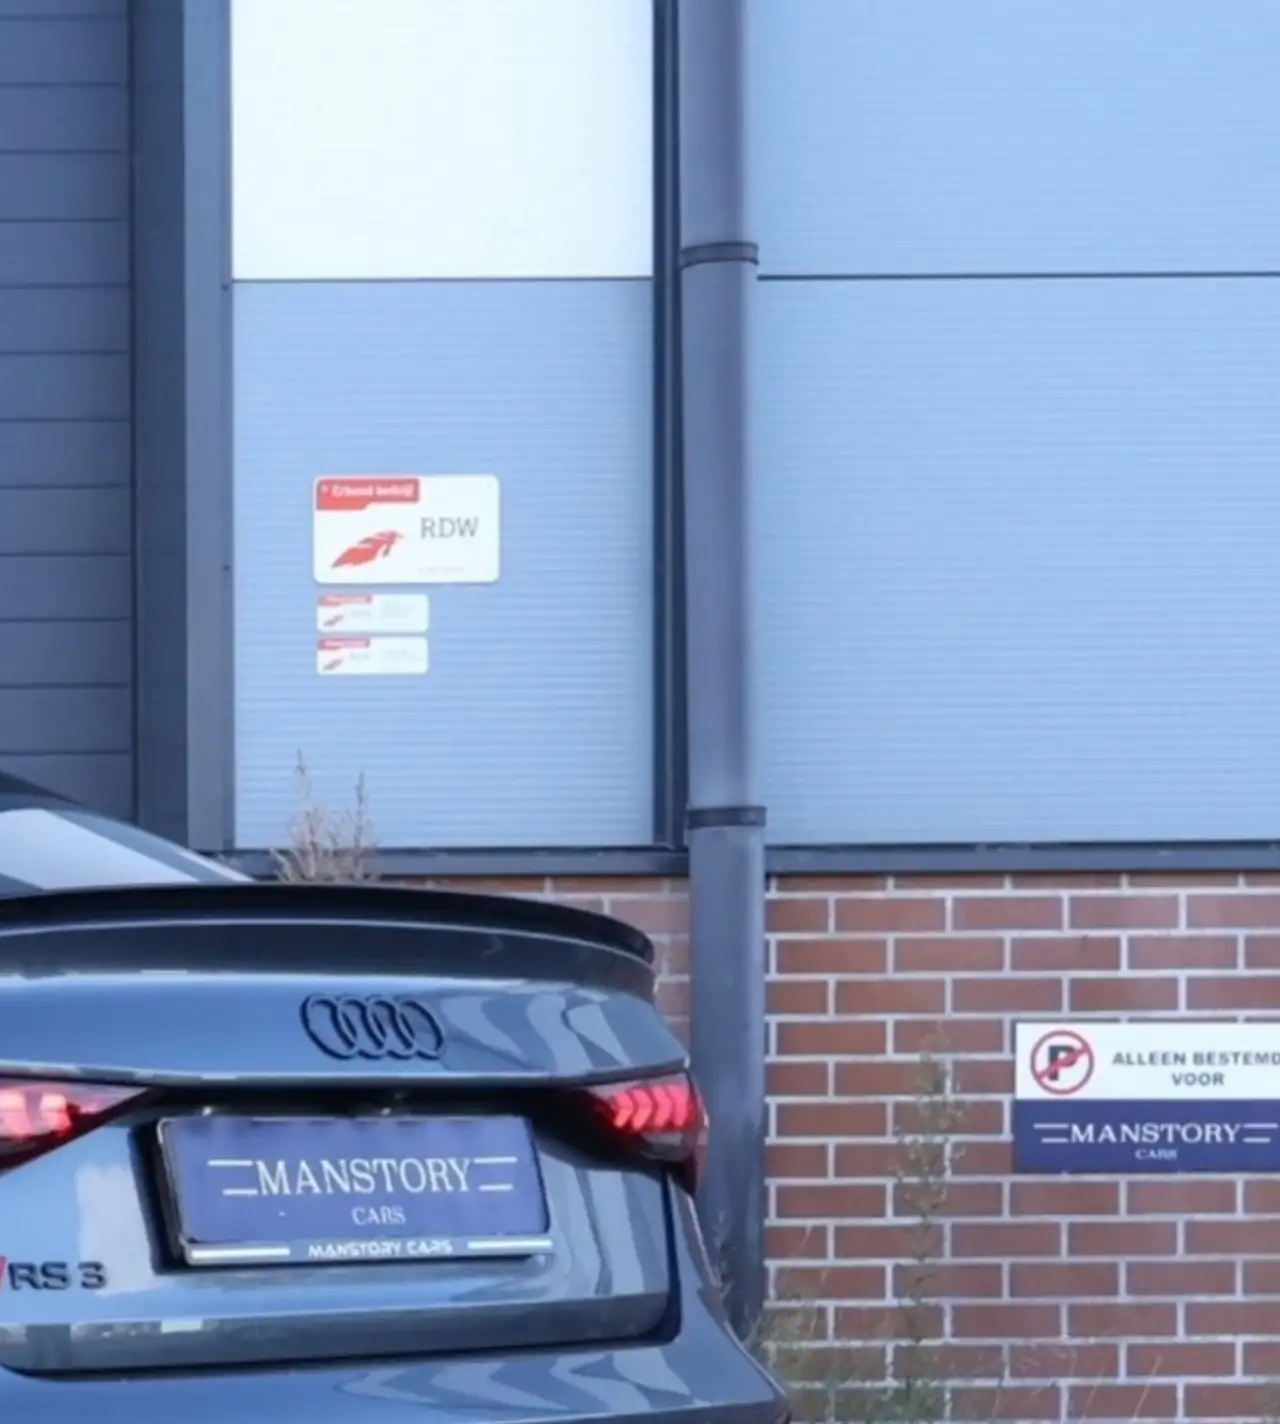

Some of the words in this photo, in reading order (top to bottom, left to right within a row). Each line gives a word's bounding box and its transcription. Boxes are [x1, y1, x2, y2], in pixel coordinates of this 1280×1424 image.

[420, 516, 479, 539] RDW
[1112, 1051, 1186, 1066] ALLEEN
[1171, 1072, 1225, 1086] VOOR
[1071, 1123, 1241, 1144] MANSTORY
[1135, 1149, 1177, 1160] CARS
[256, 1158, 473, 1196] MANSTORY
[352, 1206, 406, 1226] CARS
[308, 1242, 402, 1259] MANSTORY
[407, 1239, 453, 1254] CARS
[8, 1262, 70, 1291] RS
[78, 1261, 107, 1289] 3
